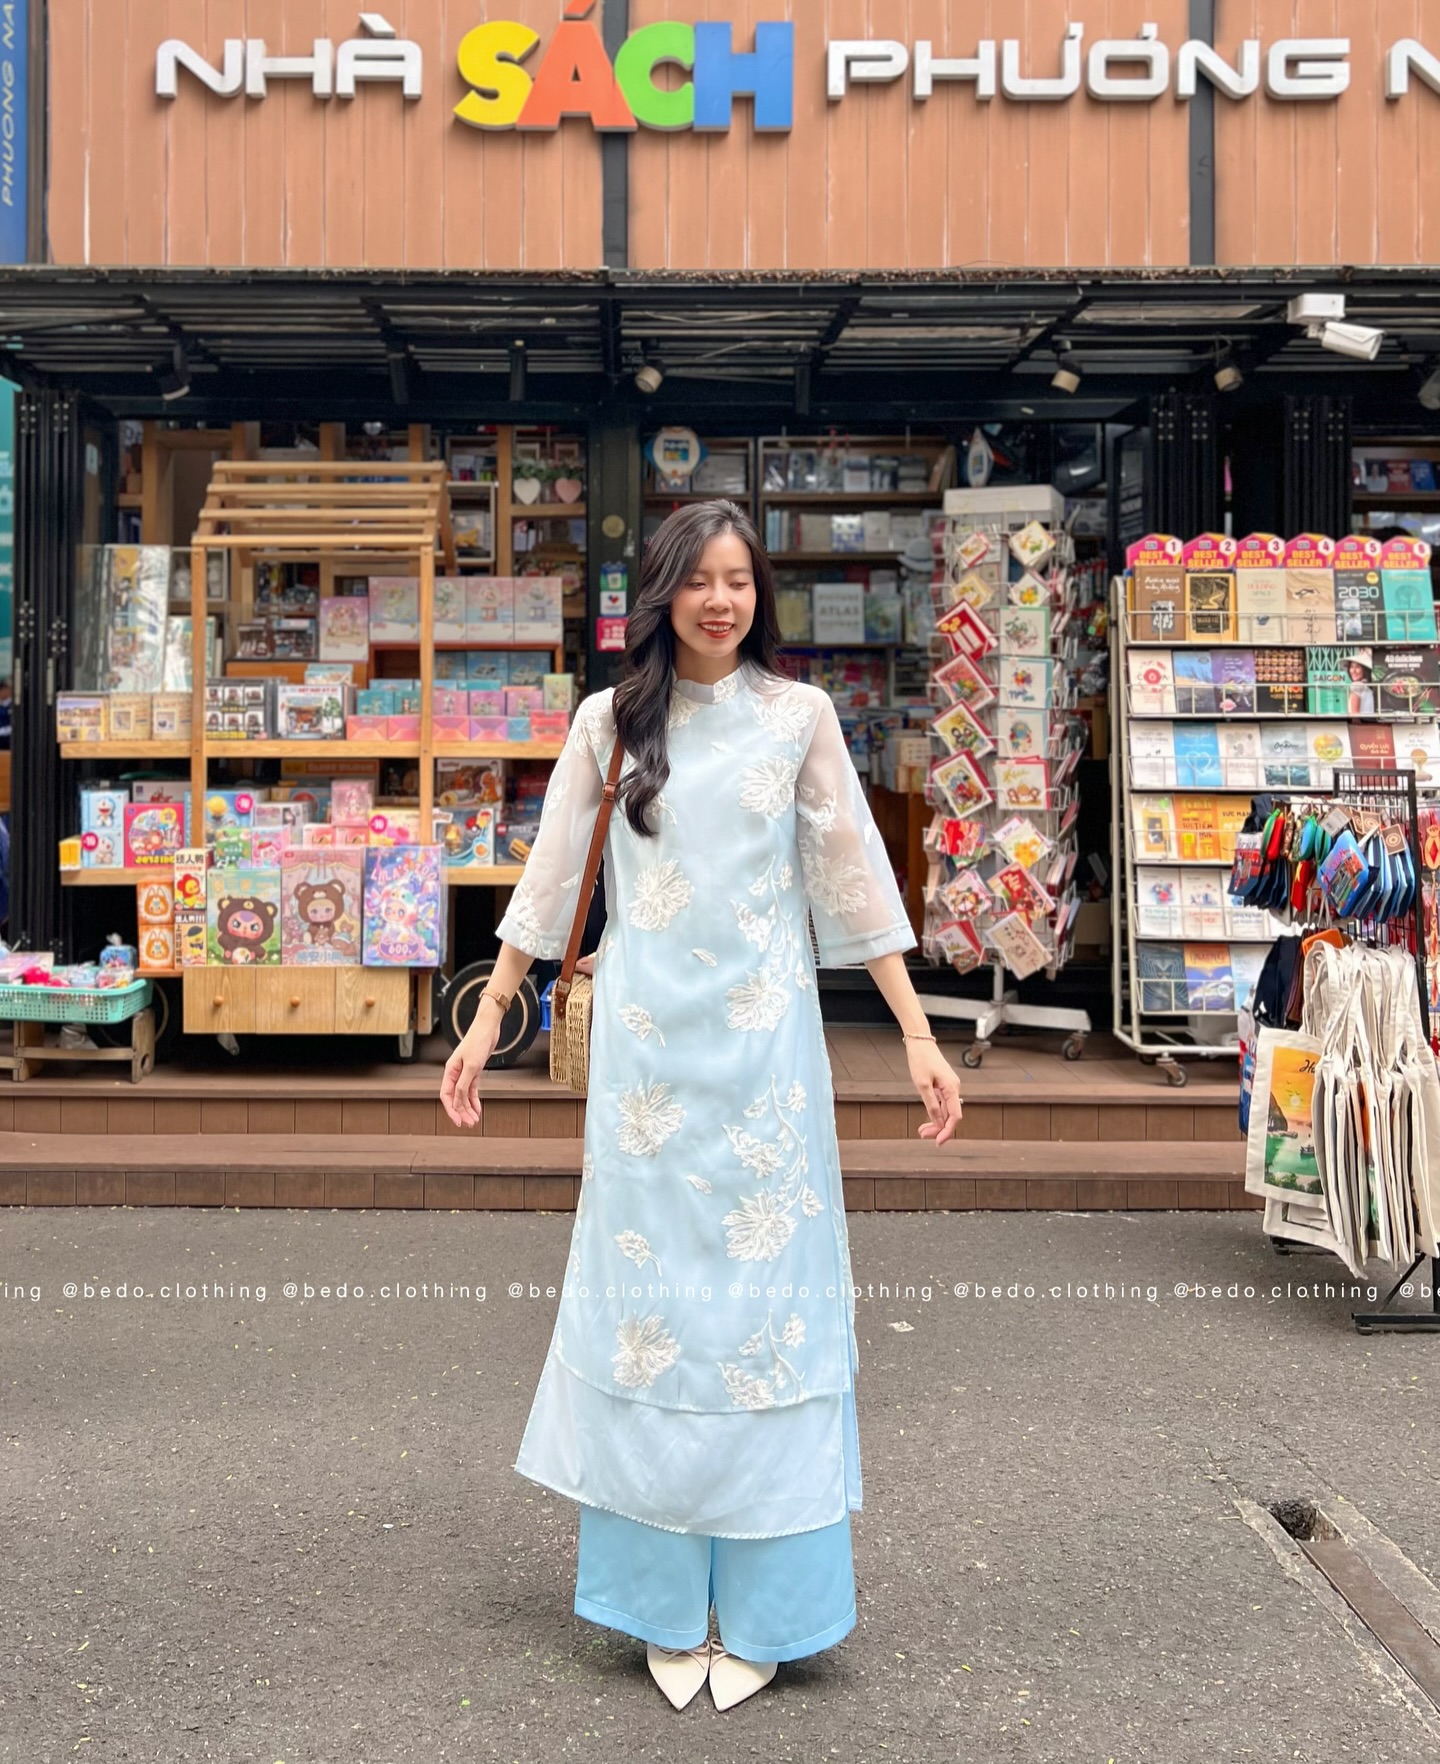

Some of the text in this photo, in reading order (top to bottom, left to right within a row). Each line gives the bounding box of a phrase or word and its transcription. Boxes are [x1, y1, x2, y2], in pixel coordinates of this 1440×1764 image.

[2, 0, 14, 50] NA
[155, 12, 423, 99] NHÀ
[453, 0, 793, 133] SÁCH
[1170, 541, 1176, 552] 1
[1224, 541, 1232, 552] 2
[1272, 541, 1280, 552] 3
[1323, 541, 1330, 552] 4
[1370, 542, 1377, 553] 5
[1139, 551, 1164, 559] BEST
[1193, 550, 1217, 559] BEST
[1242, 550, 1266, 559] BEST
[1292, 550, 1316, 559] BEST
[1339, 552, 1363, 560] BEST
[1387, 552, 1411, 561] BEST
[1188, 559, 1224, 568] SELLER
[1237, 559, 1272, 568] SELLER
[1287, 559, 1322, 568] SELLER
[1335, 560, 1370, 569] SELLER
[1383, 560, 1419, 569] SELLER
[1338, 587, 1379, 598] 2030
[1313, 674, 1345, 682] SAIGON
